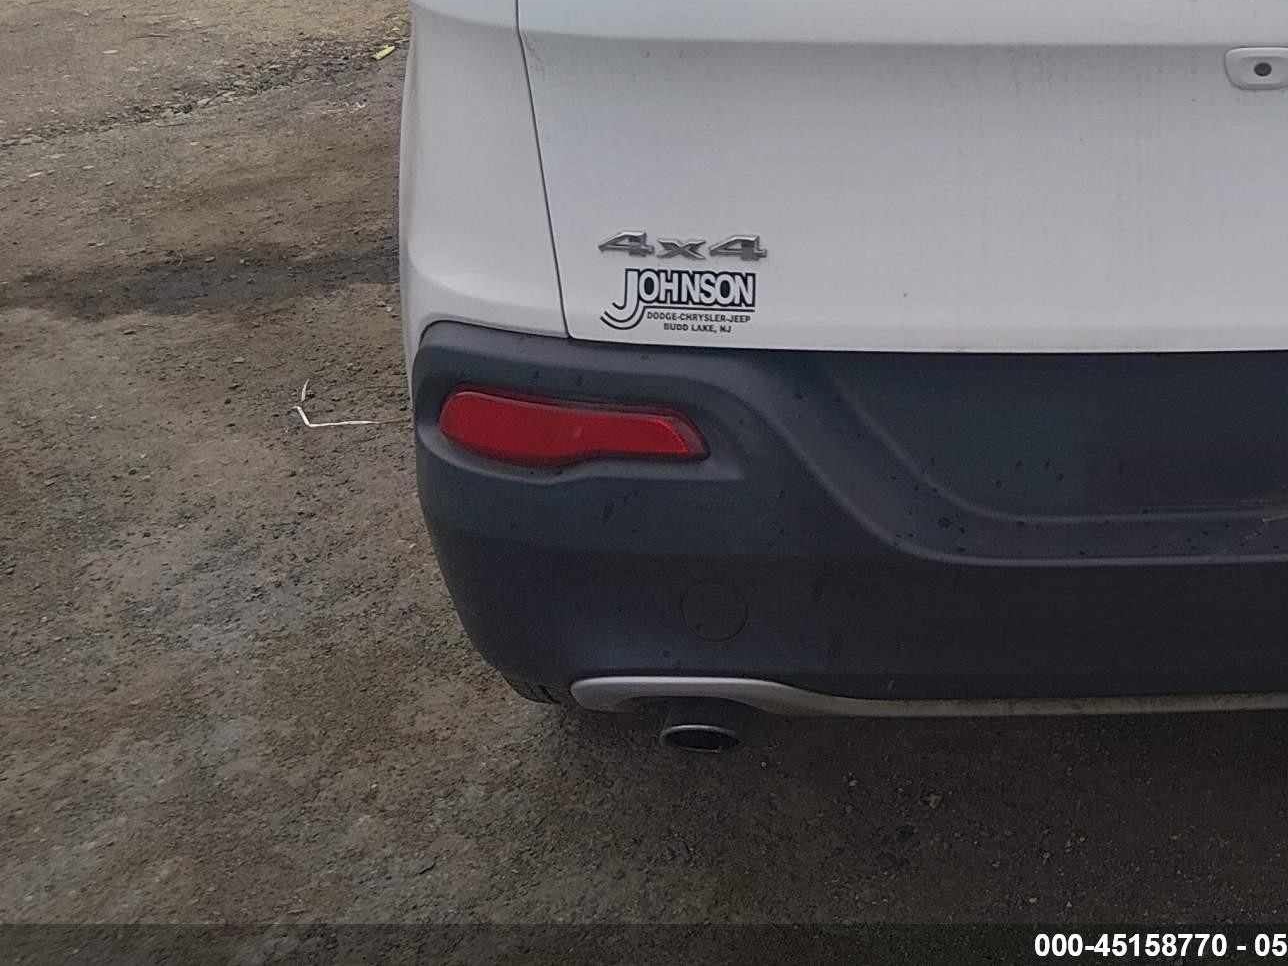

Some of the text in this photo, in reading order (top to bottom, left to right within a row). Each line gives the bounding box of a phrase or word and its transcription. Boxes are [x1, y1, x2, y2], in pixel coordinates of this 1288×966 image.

[598, 230, 767, 261] 4x4
[602, 267, 757, 326] JOHNSON
[646, 311, 752, 323] DODGE-CHRYSLER-JEEP
[663, 322, 690, 331] BUDD
[720, 325, 732, 333] NJ
